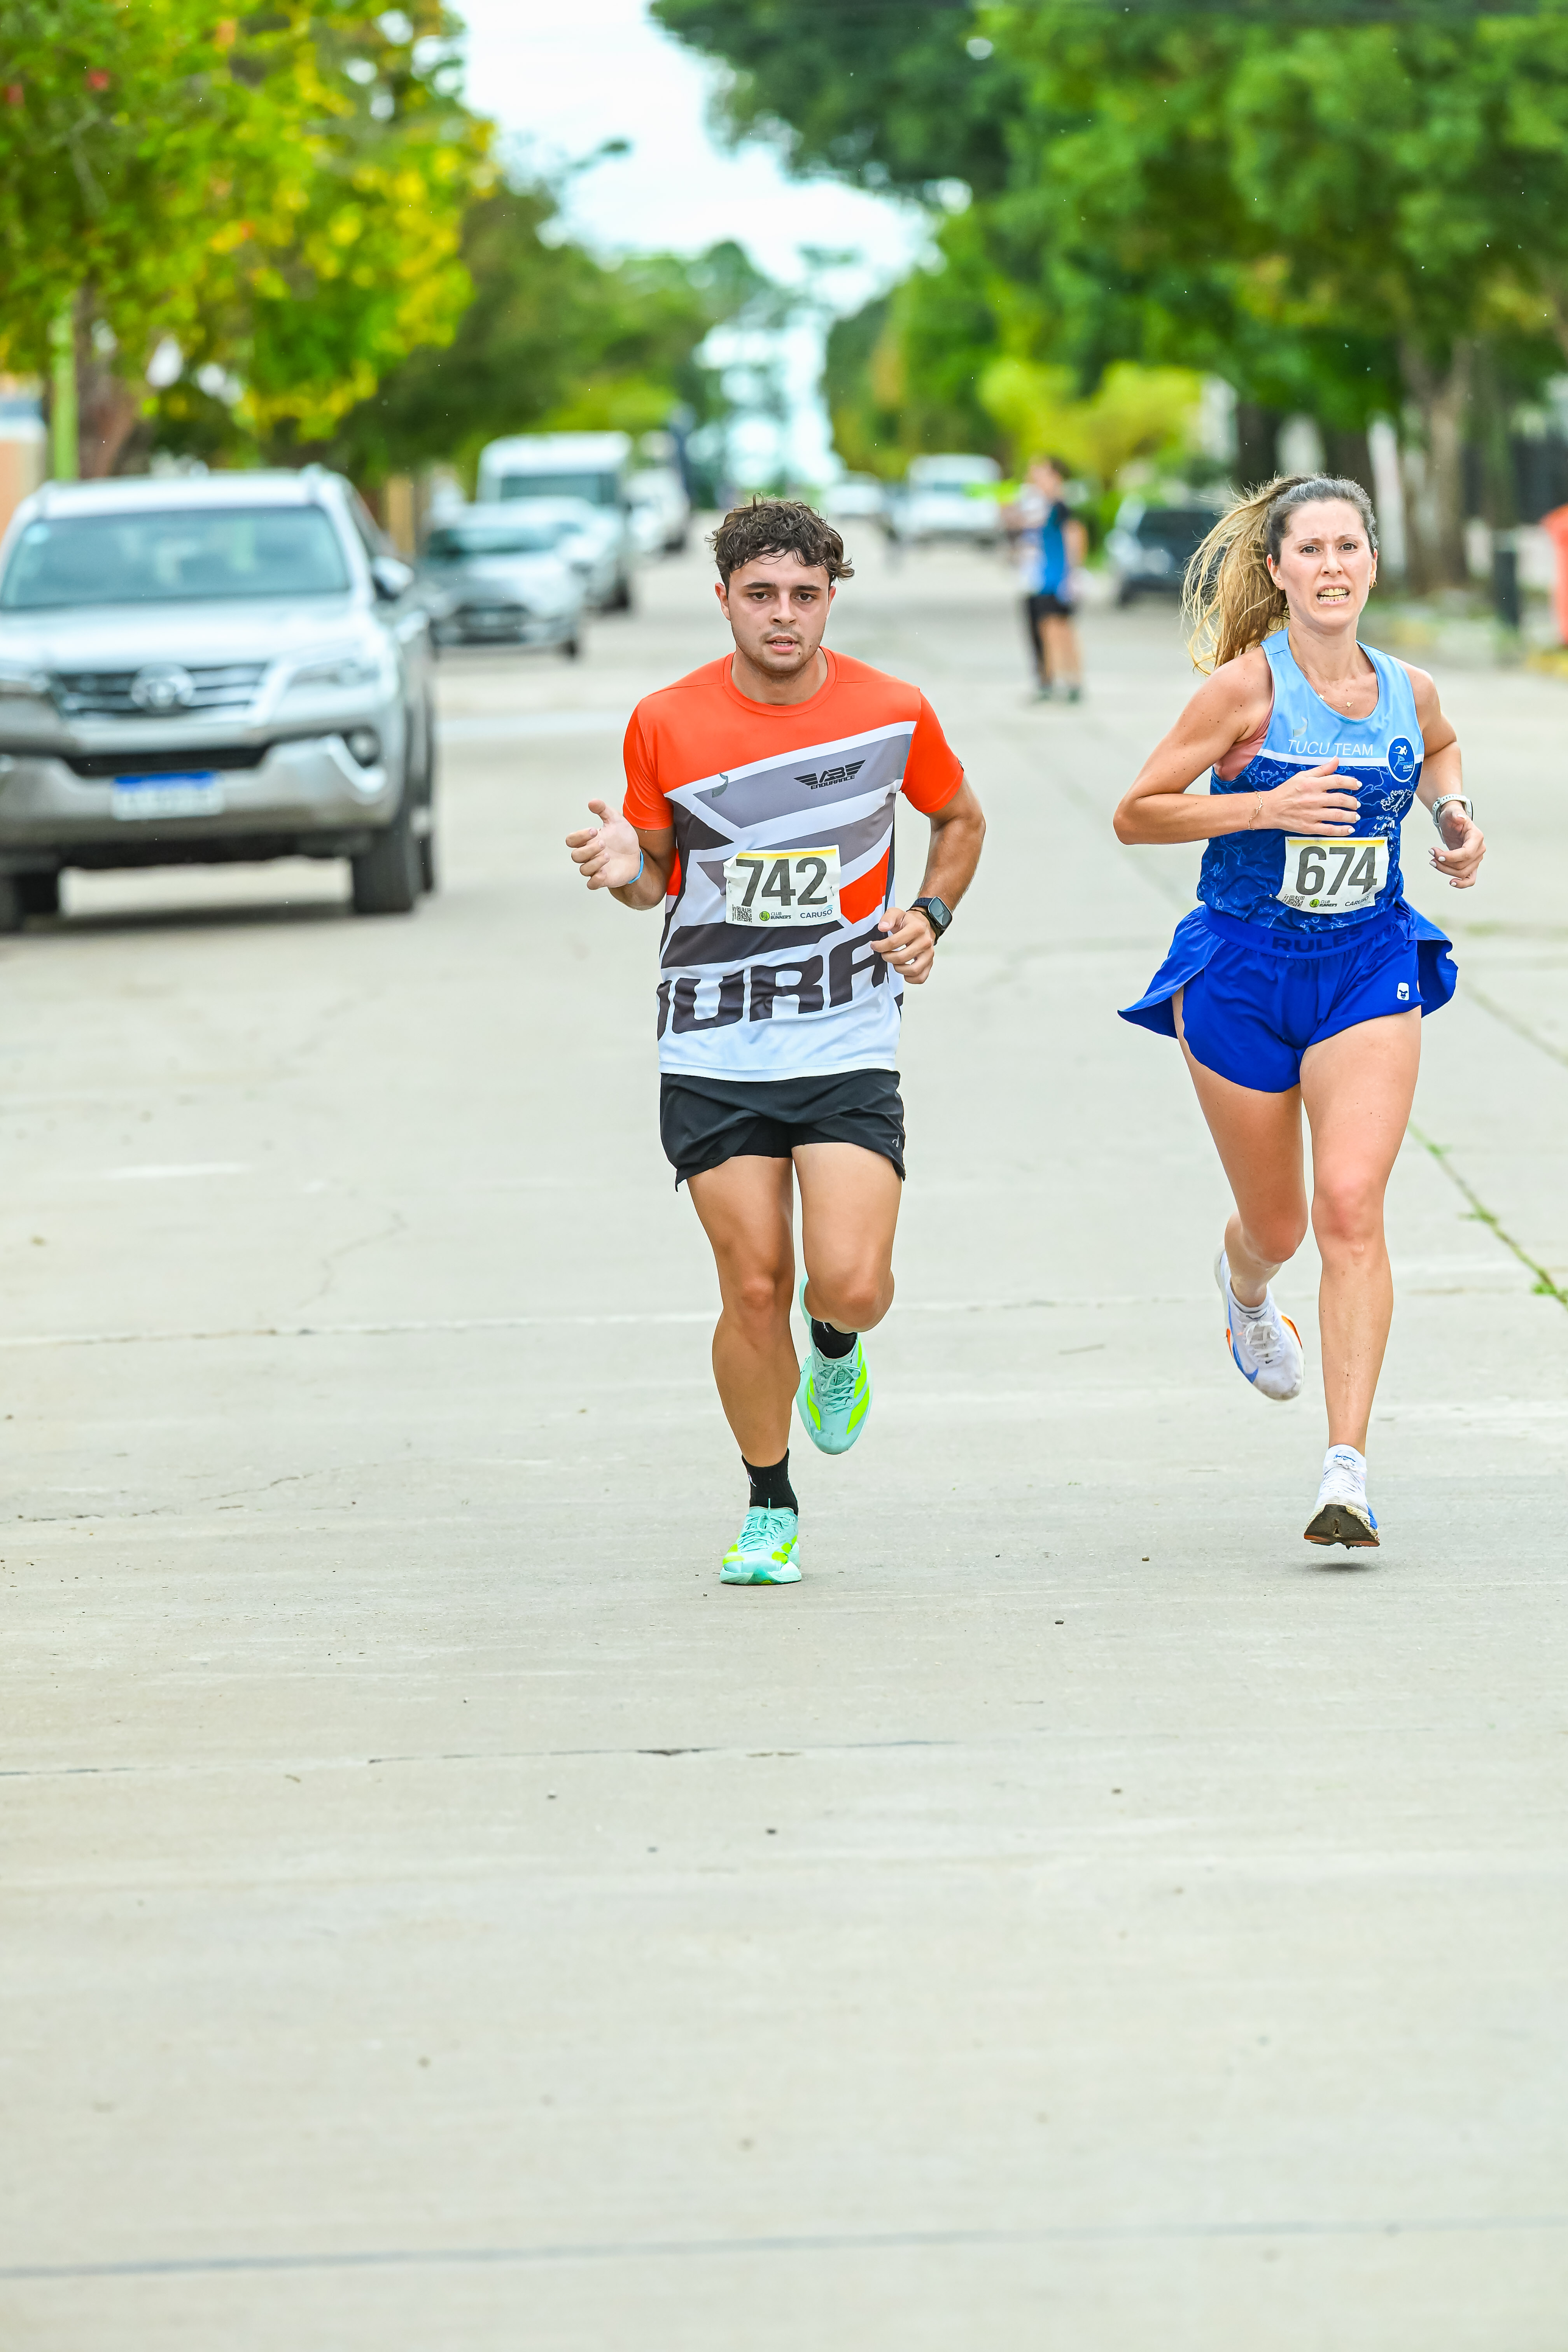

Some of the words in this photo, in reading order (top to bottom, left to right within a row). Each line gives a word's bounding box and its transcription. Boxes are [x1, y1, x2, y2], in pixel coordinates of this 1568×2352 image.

[1288, 739, 1330, 755] TUCU
[1334, 743, 1373, 756] TEAM
[810, 775, 855, 790] ENDURANCE
[1296, 846, 1377, 895] 674
[736, 858, 827, 906] 742
[800, 909, 832, 919] CARUSO
[1272, 929, 1363, 952] RULES
